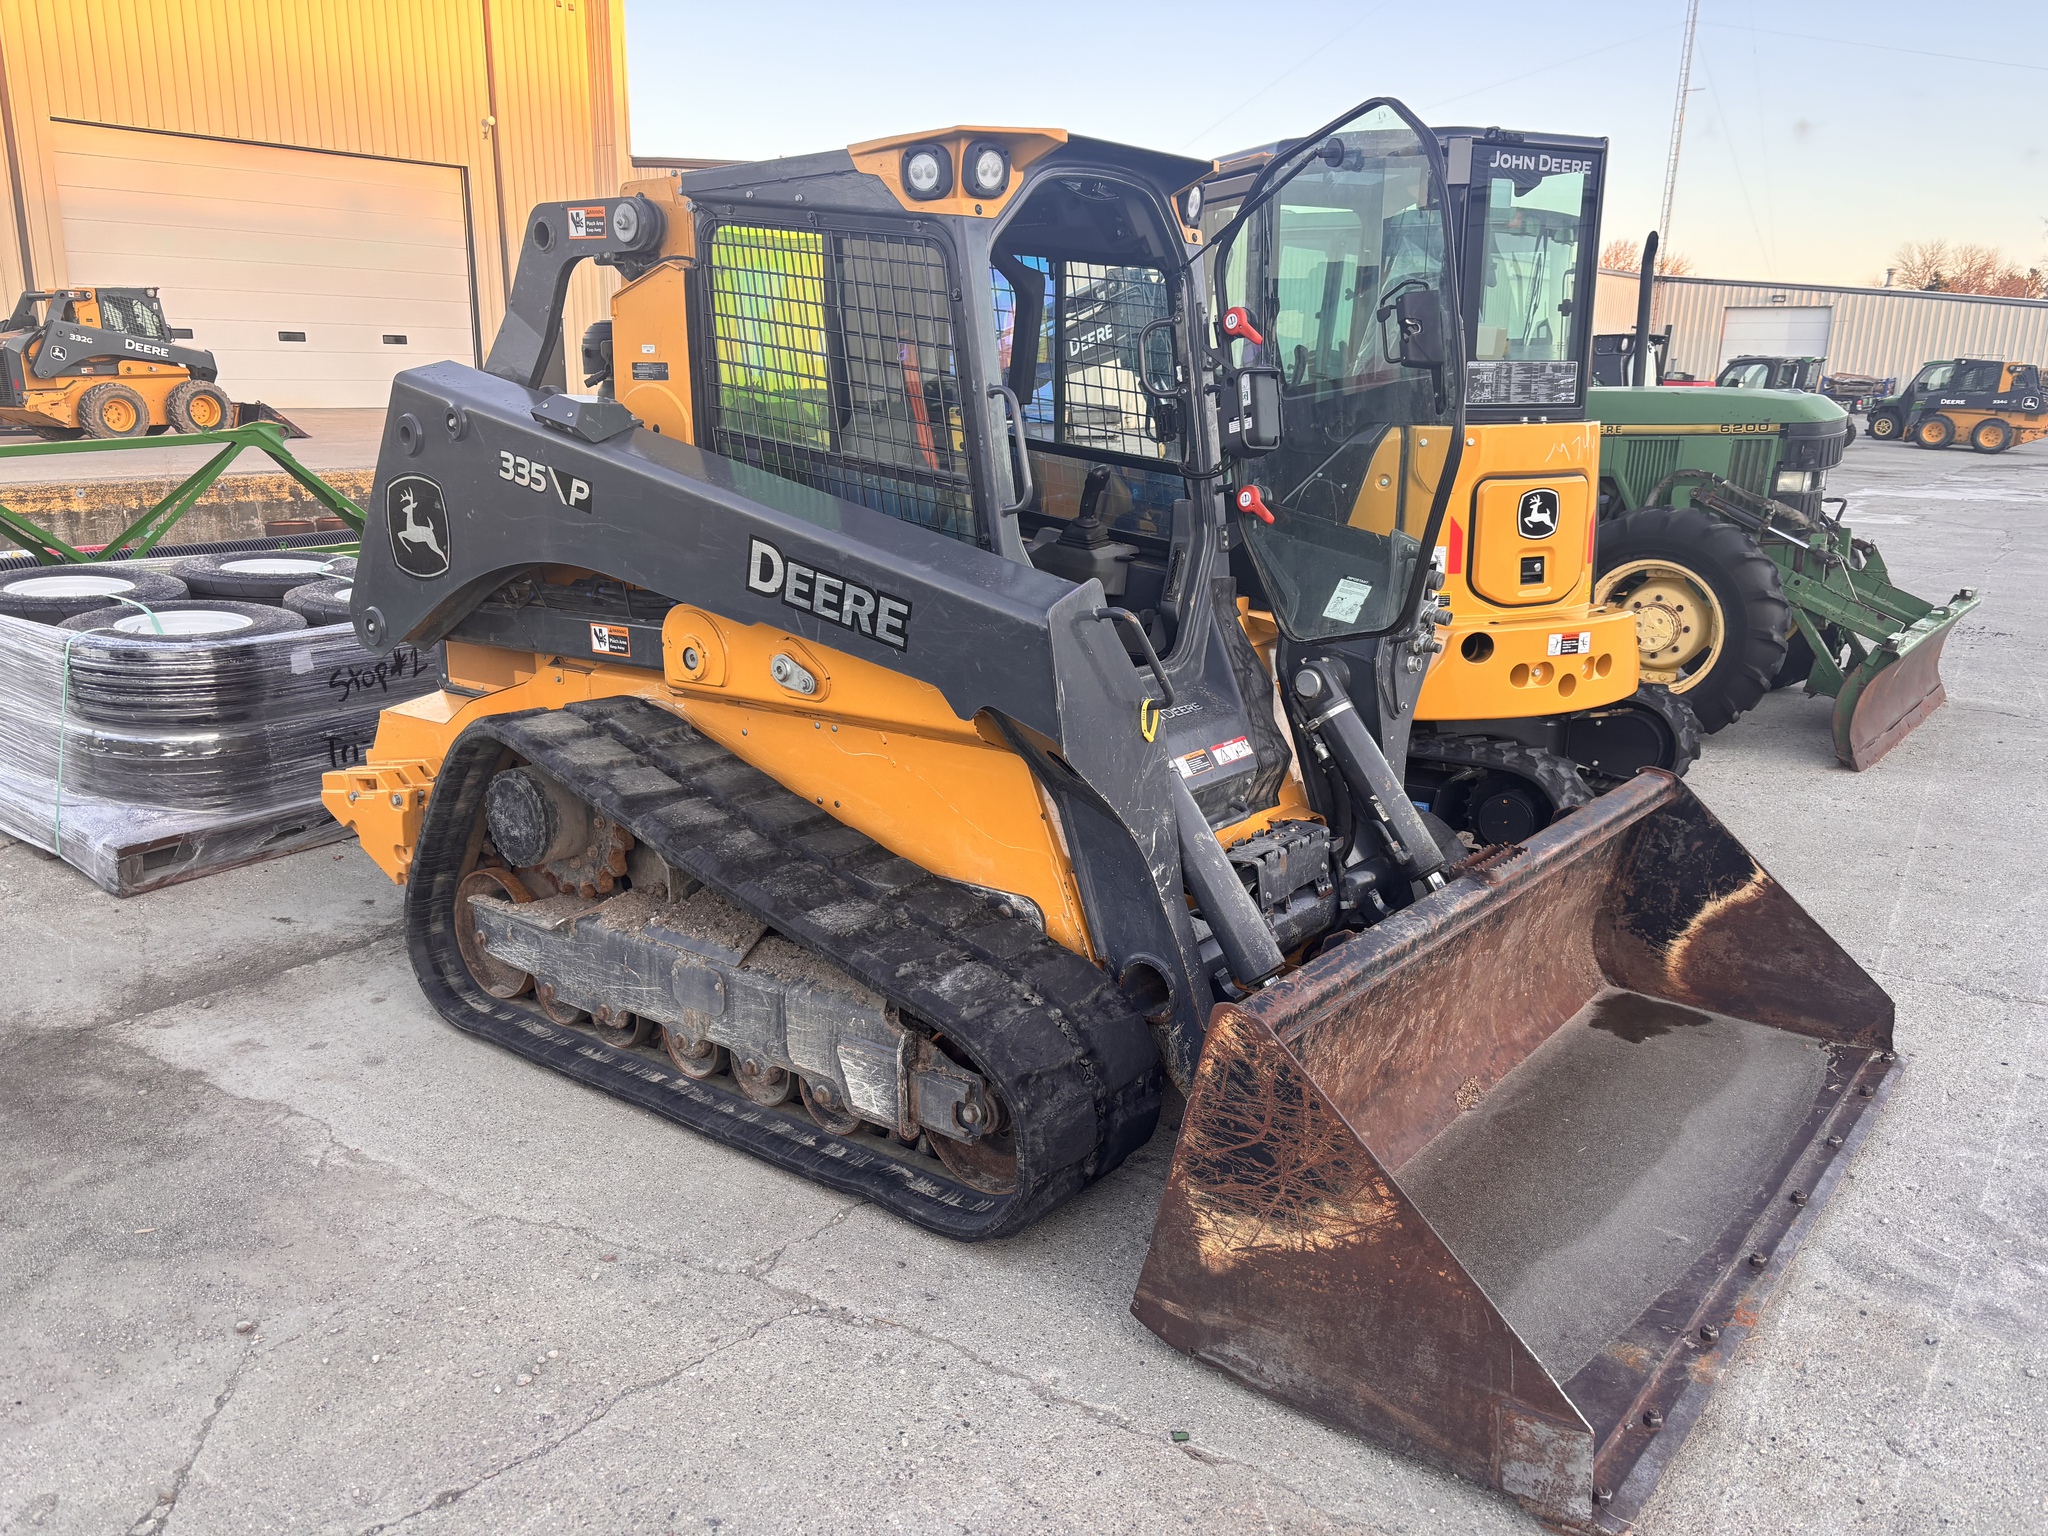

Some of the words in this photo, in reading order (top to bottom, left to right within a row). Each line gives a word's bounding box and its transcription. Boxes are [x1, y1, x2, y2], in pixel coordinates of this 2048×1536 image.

[1490, 151, 1535, 171] JOHN
[1538, 154, 1592, 175] DEERE
[69, 333, 93, 344] 332G
[125, 338, 169, 357] DEERE
[1069, 324, 1113, 357] DEERE
[1719, 423, 1770, 434] 6200
[748, 538, 910, 648] DEERE
[1160, 702, 1203, 720] DEERE
